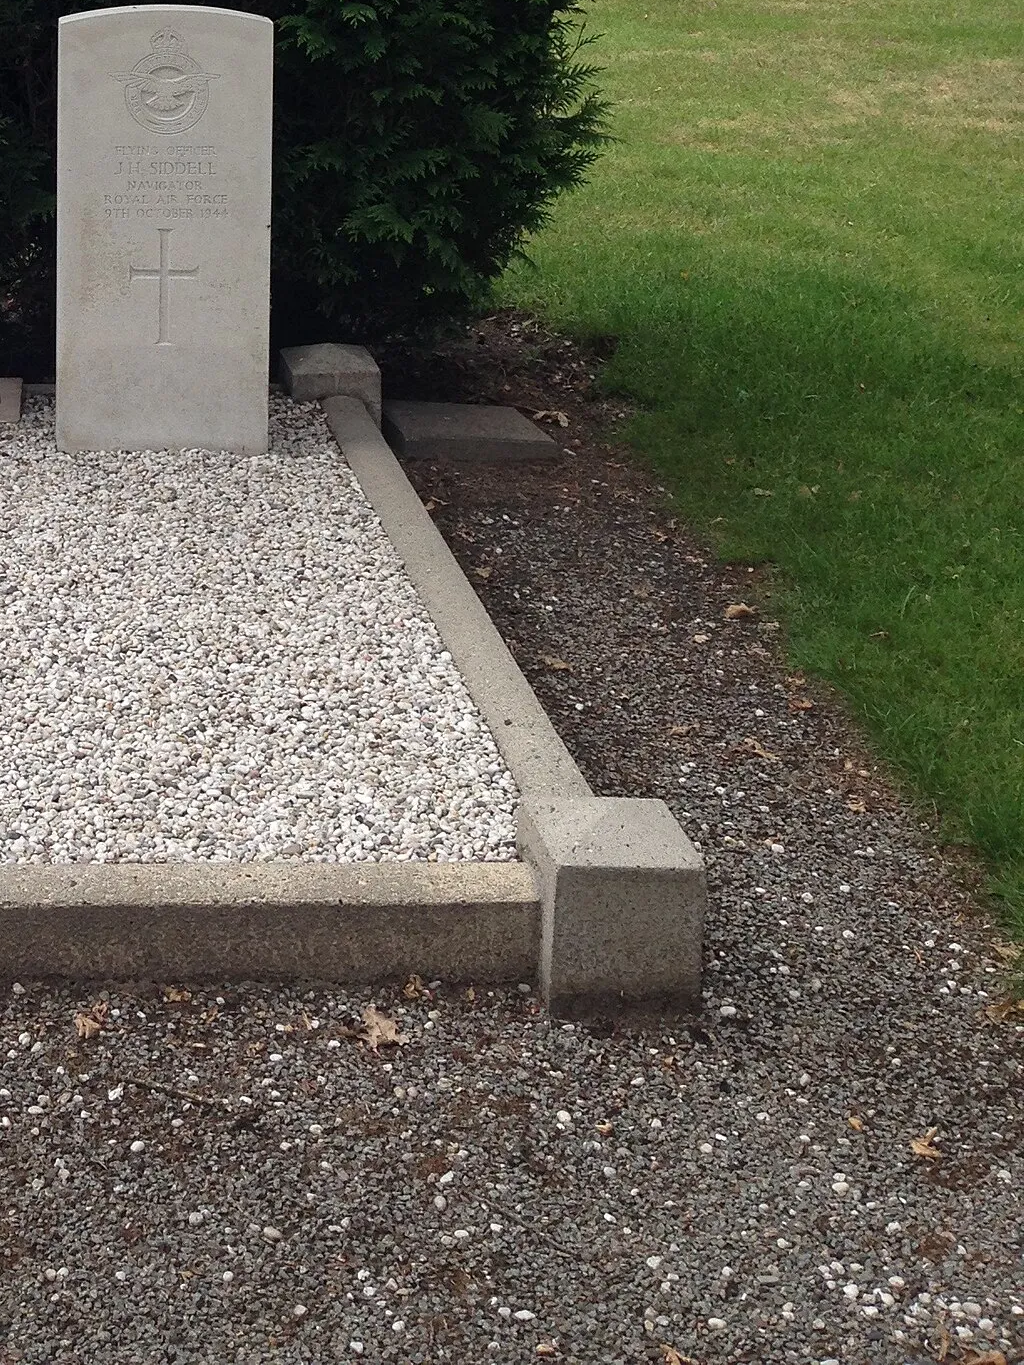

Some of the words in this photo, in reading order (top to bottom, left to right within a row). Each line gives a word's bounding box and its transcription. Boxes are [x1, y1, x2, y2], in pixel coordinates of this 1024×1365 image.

[114, 145, 160, 156] FLYING
[166, 145, 218, 156] OFFICER
[149, 161, 218, 176] SIDDELL
[126, 180, 204, 191] NAVIGATOR
[103, 194, 149, 205] ROYAL
[156, 194, 179, 205] AIR
[186, 194, 229, 205] FORCE
[104, 208, 130, 219] 9TH
[136, 208, 194, 219] OCTOBER
[200, 208, 230, 219] 1944
